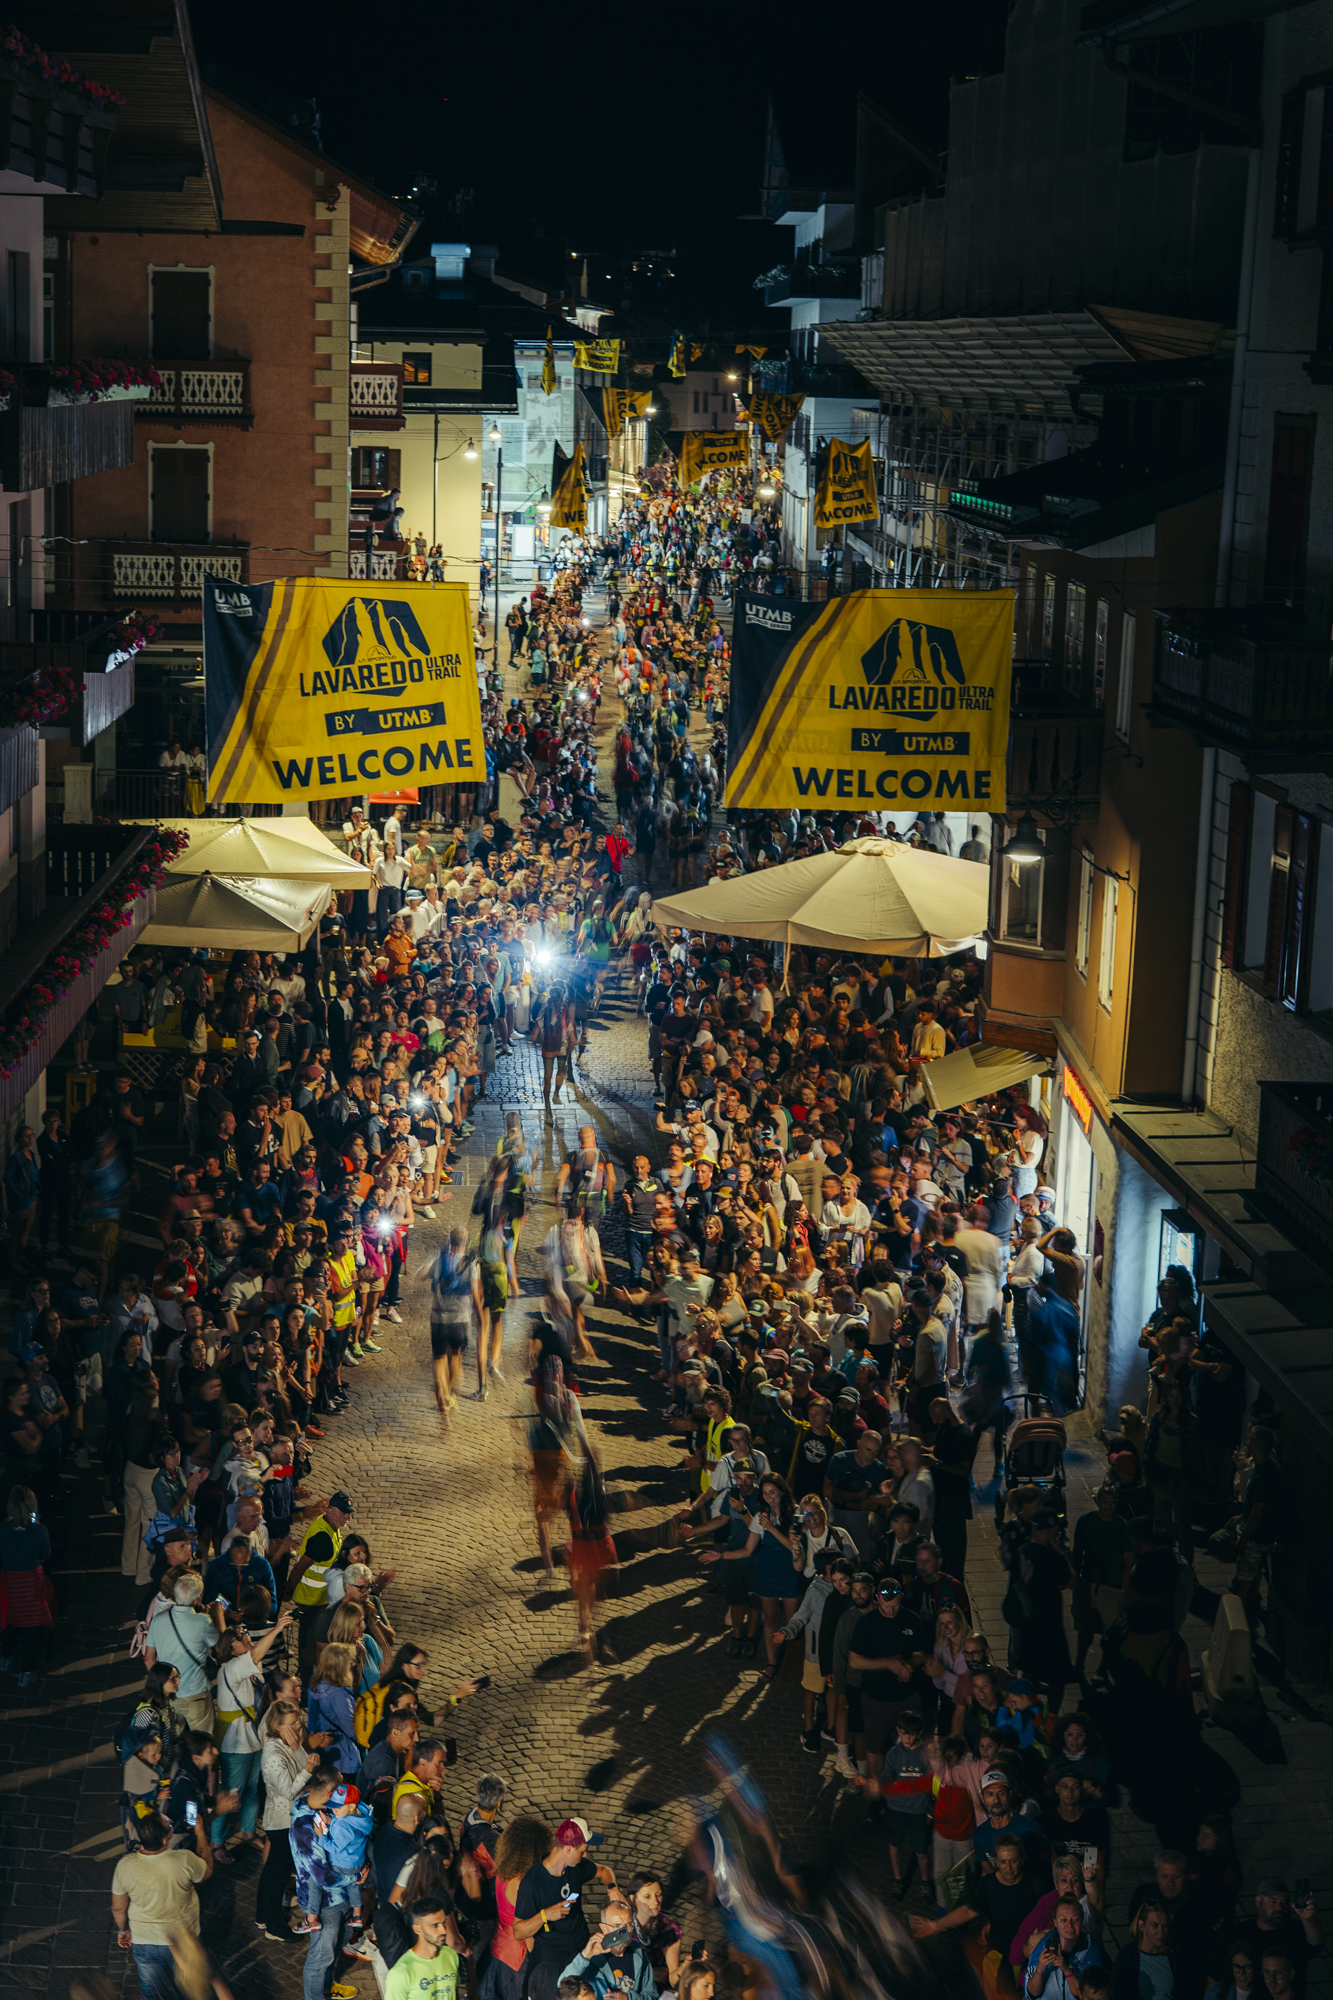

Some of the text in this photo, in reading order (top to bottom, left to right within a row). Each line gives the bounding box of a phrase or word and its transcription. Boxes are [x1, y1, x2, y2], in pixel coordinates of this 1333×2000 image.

[745, 602, 793, 623] UTMB
[747, 616, 768, 626] WORLD
[425, 653, 462, 669] ULTRA
[300, 658, 424, 697] LAVAREDO
[427, 666, 461, 681] TRAIL
[829, 685, 956, 711] LAVAREDO
[958, 685, 995, 699] ULTRA
[959, 698, 992, 711] TRAIL
[334, 708, 432, 731] BY UTMB
[861, 732, 955, 752] BY UTMB
[272, 738, 474, 790] WELCOME
[792, 767, 991, 799] WELCOME
